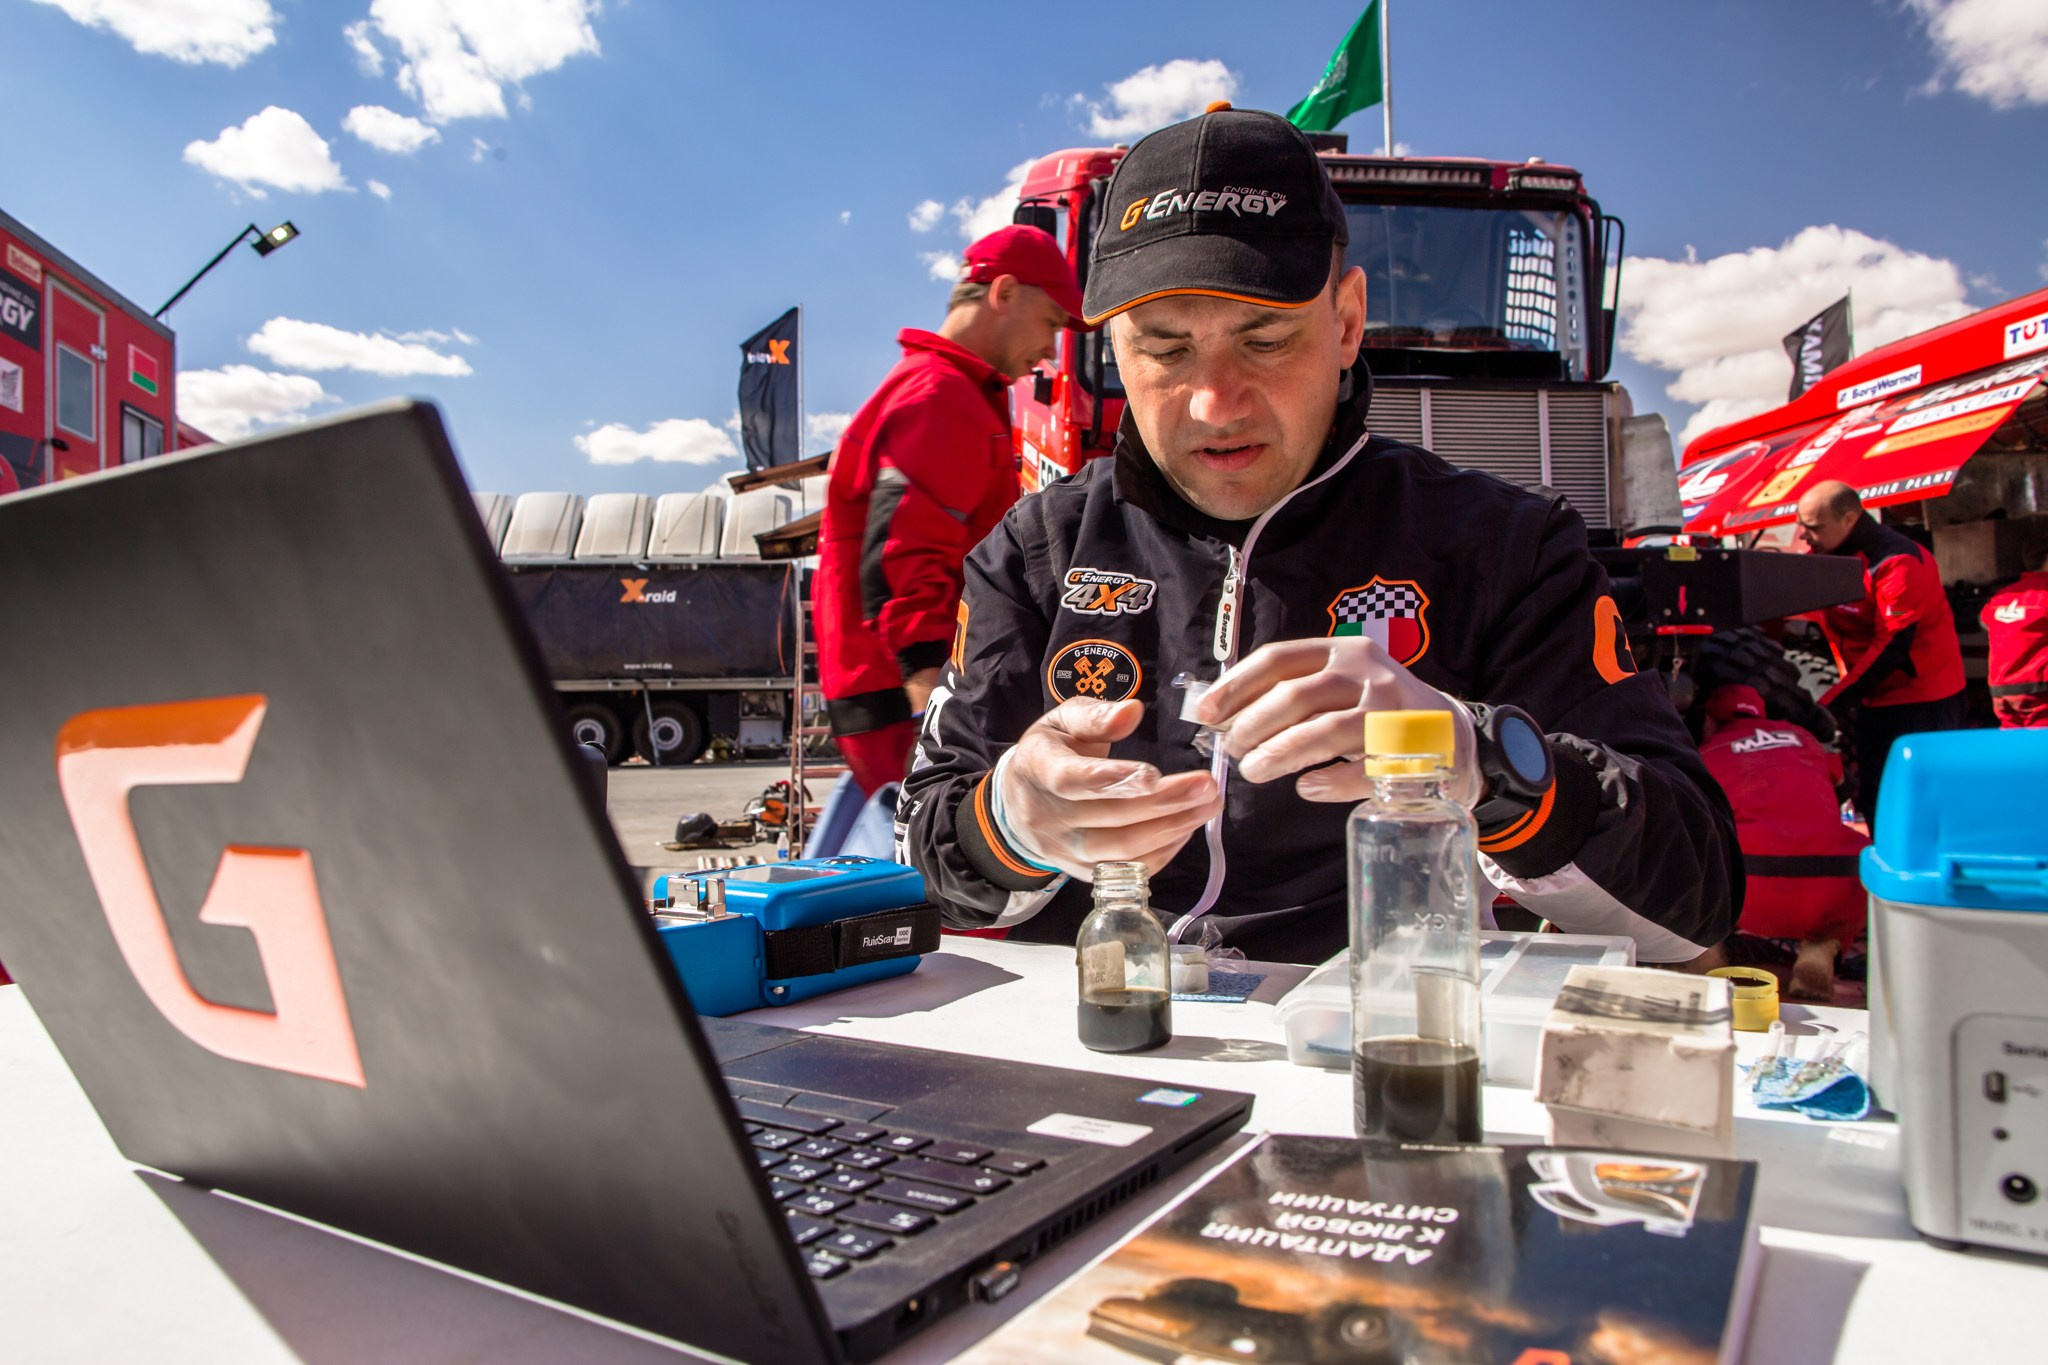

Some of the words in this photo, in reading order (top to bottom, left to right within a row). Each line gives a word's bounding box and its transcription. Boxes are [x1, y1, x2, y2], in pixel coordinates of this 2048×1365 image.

[1223, 185, 1269, 197] ENGINE
[1271, 191, 1287, 200] OIL
[1851, 370, 1920, 401] BorgWarner
[1074, 647, 1120, 660] G-ENERGY
[862, 934, 896, 948] FluidScan
[1267, 1191, 1460, 1224] СИТУАЦИИ
[1274, 1211, 1415, 1241] ЛЮБОЙ
[1415, 1226, 1446, 1245] К
[1200, 1221, 1433, 1266] АДАПТАЦИЯ
